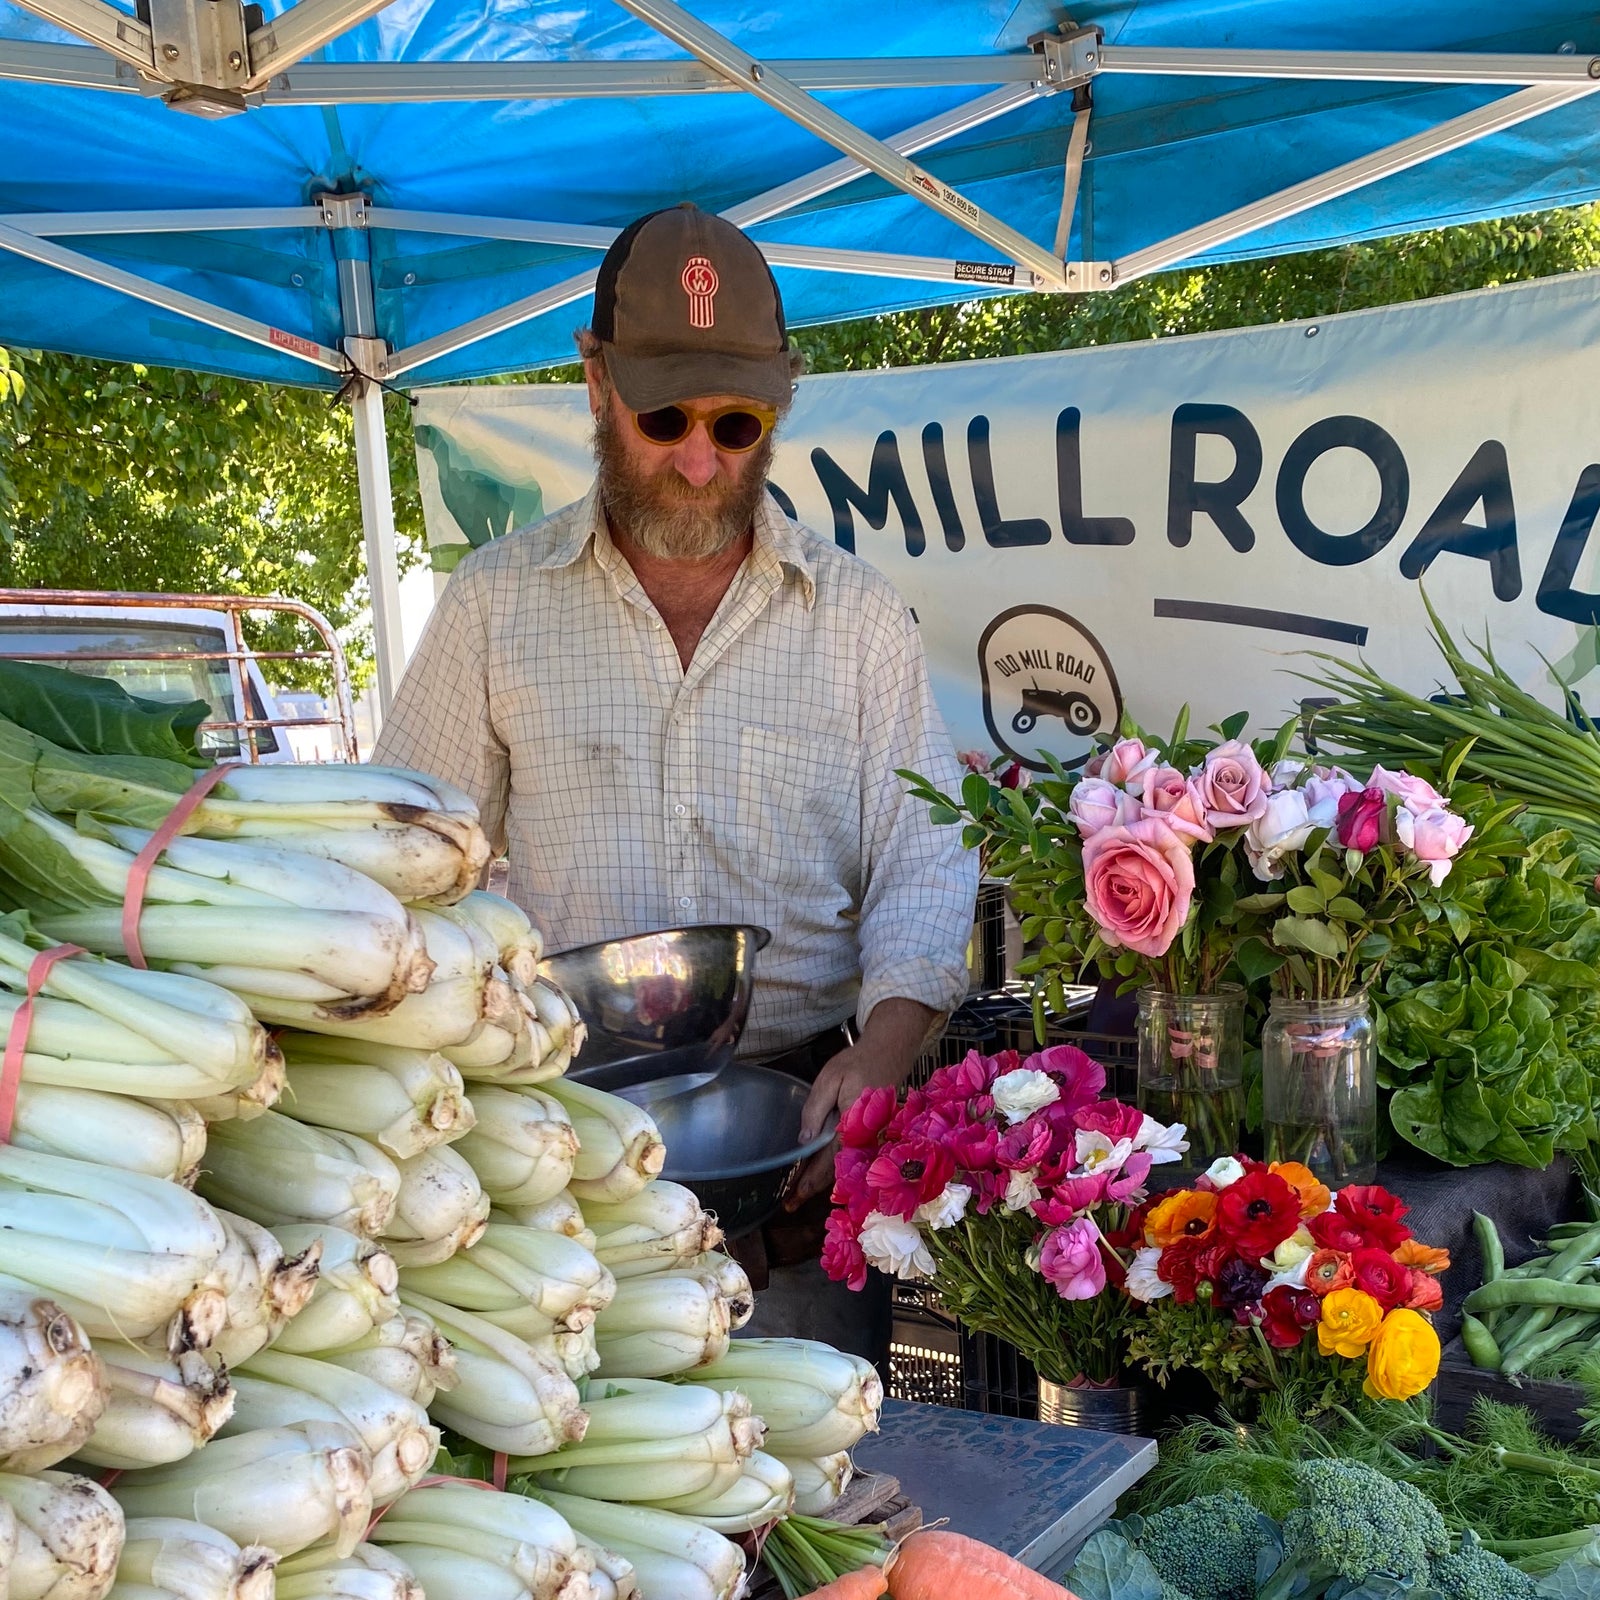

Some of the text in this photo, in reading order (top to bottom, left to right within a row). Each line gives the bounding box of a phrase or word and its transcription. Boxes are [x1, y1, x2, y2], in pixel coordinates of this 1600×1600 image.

[956, 264, 1013, 277] SECURE STRAP
[810, 406, 1136, 557] MILL
[994, 649, 1096, 684] OLD MILL ROAD
